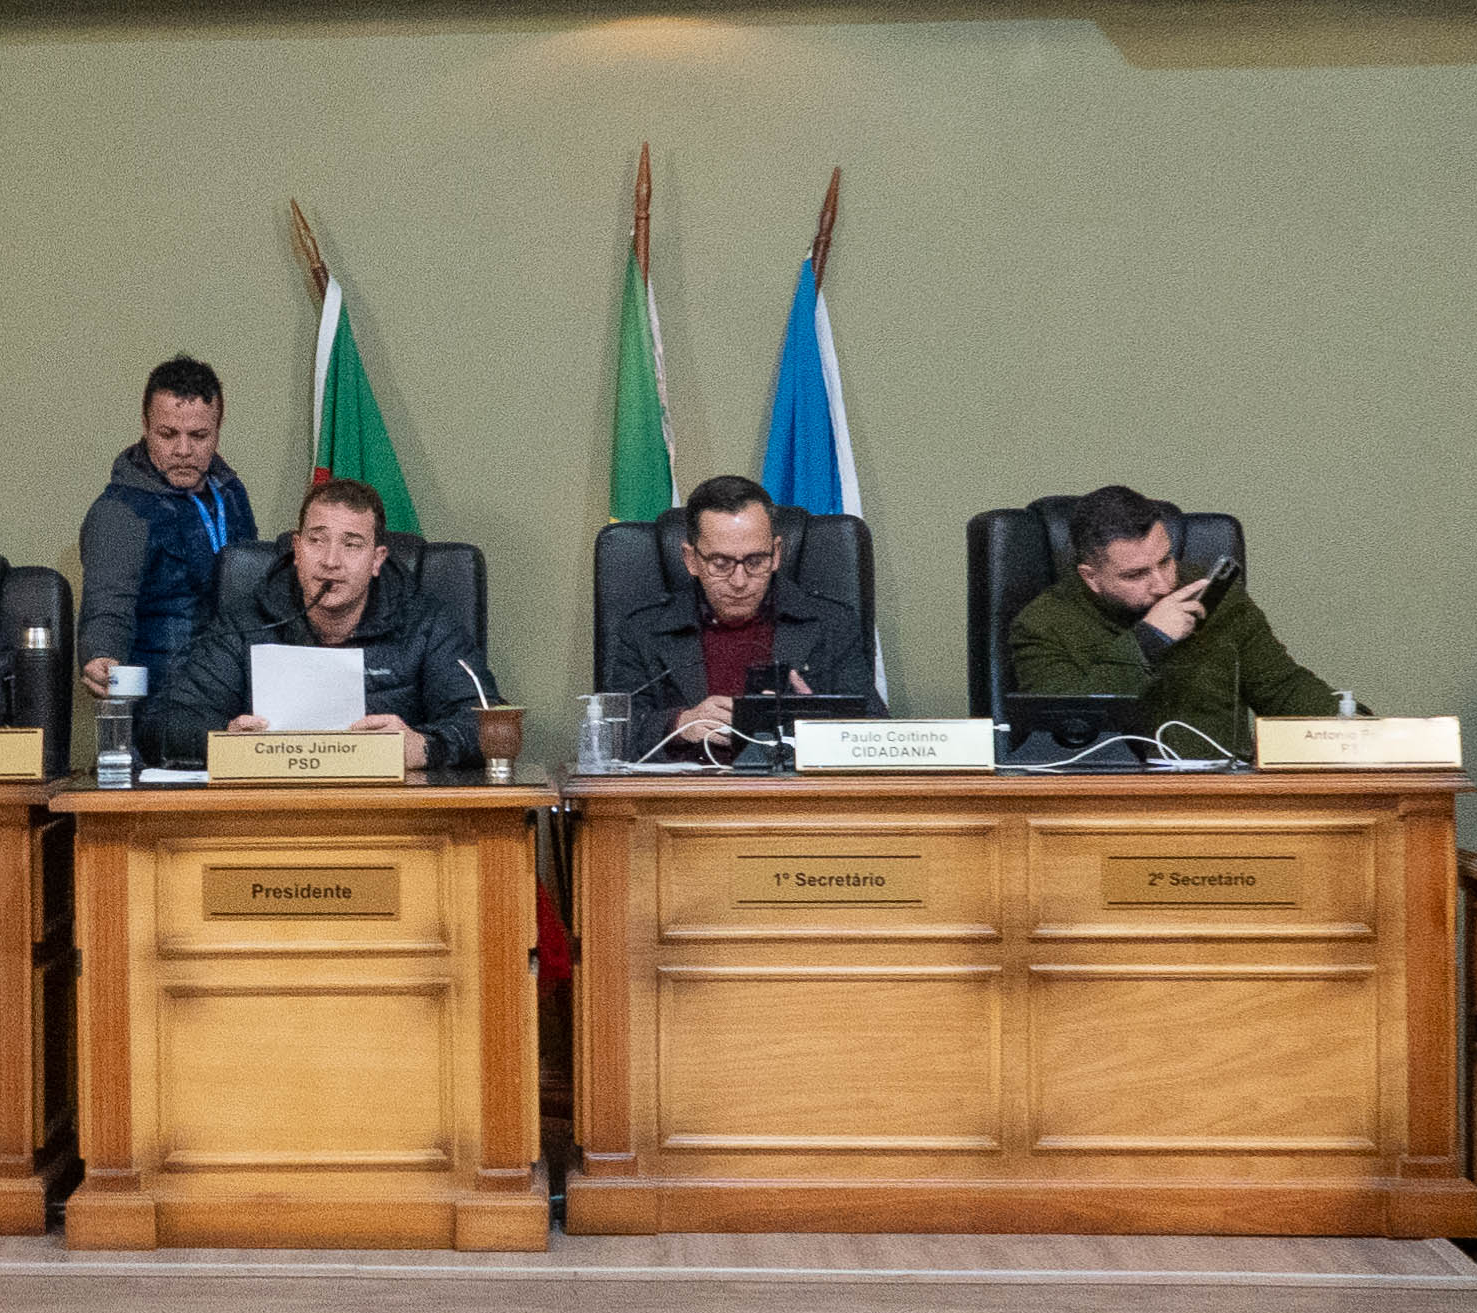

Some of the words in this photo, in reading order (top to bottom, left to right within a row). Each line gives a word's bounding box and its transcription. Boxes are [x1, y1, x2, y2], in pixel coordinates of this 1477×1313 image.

[841, 730, 881, 743] Paulo
[886, 730, 949, 743] Coitinho
[254, 741, 304, 755] Carlos
[308, 740, 358, 754] Júnior
[851, 746, 938, 758] CIDADANIA
[287, 757, 322, 770] PSD
[773, 872, 791, 887] 1º
[794, 872, 887, 888] Secretário
[1168, 872, 1257, 887] Secretário
[251, 883, 352, 899] Presidente
